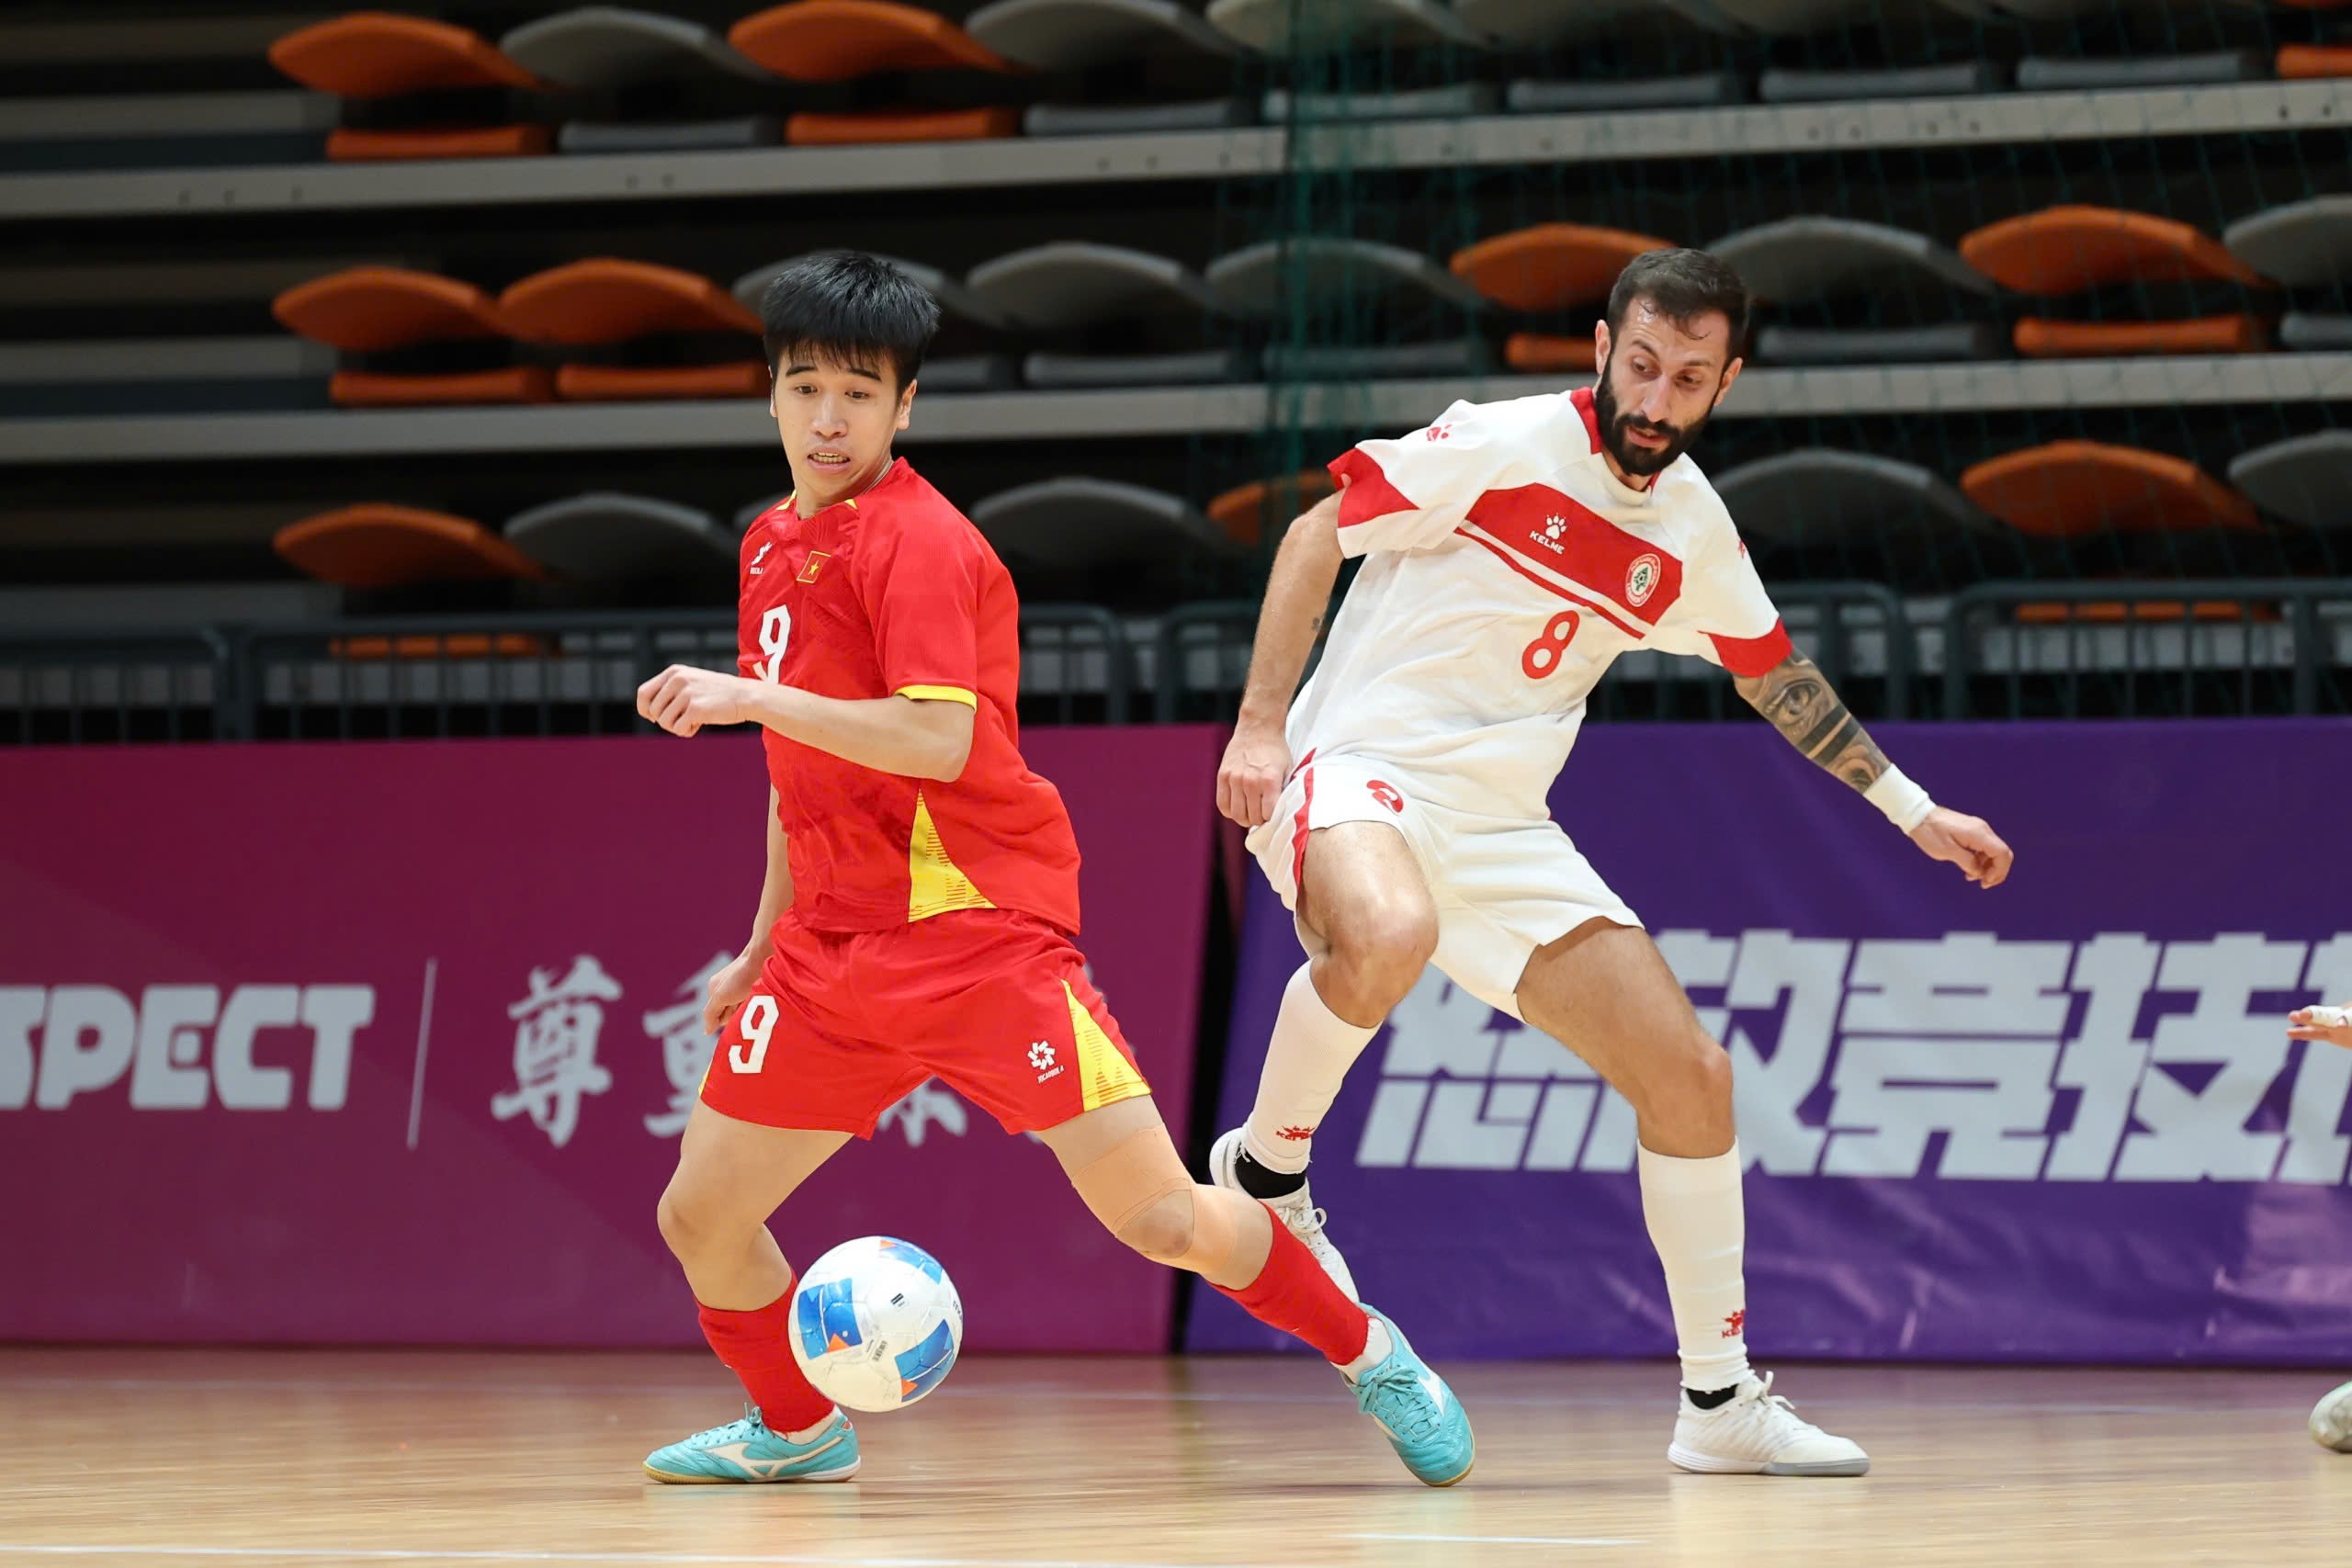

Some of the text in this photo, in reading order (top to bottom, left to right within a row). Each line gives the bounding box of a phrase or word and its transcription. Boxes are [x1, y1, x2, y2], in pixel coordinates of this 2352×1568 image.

[1530, 530, 1565, 555] KELME
[752, 604, 792, 684] 9
[1521, 610, 1579, 679] 8
[729, 995, 779, 1074] 9
